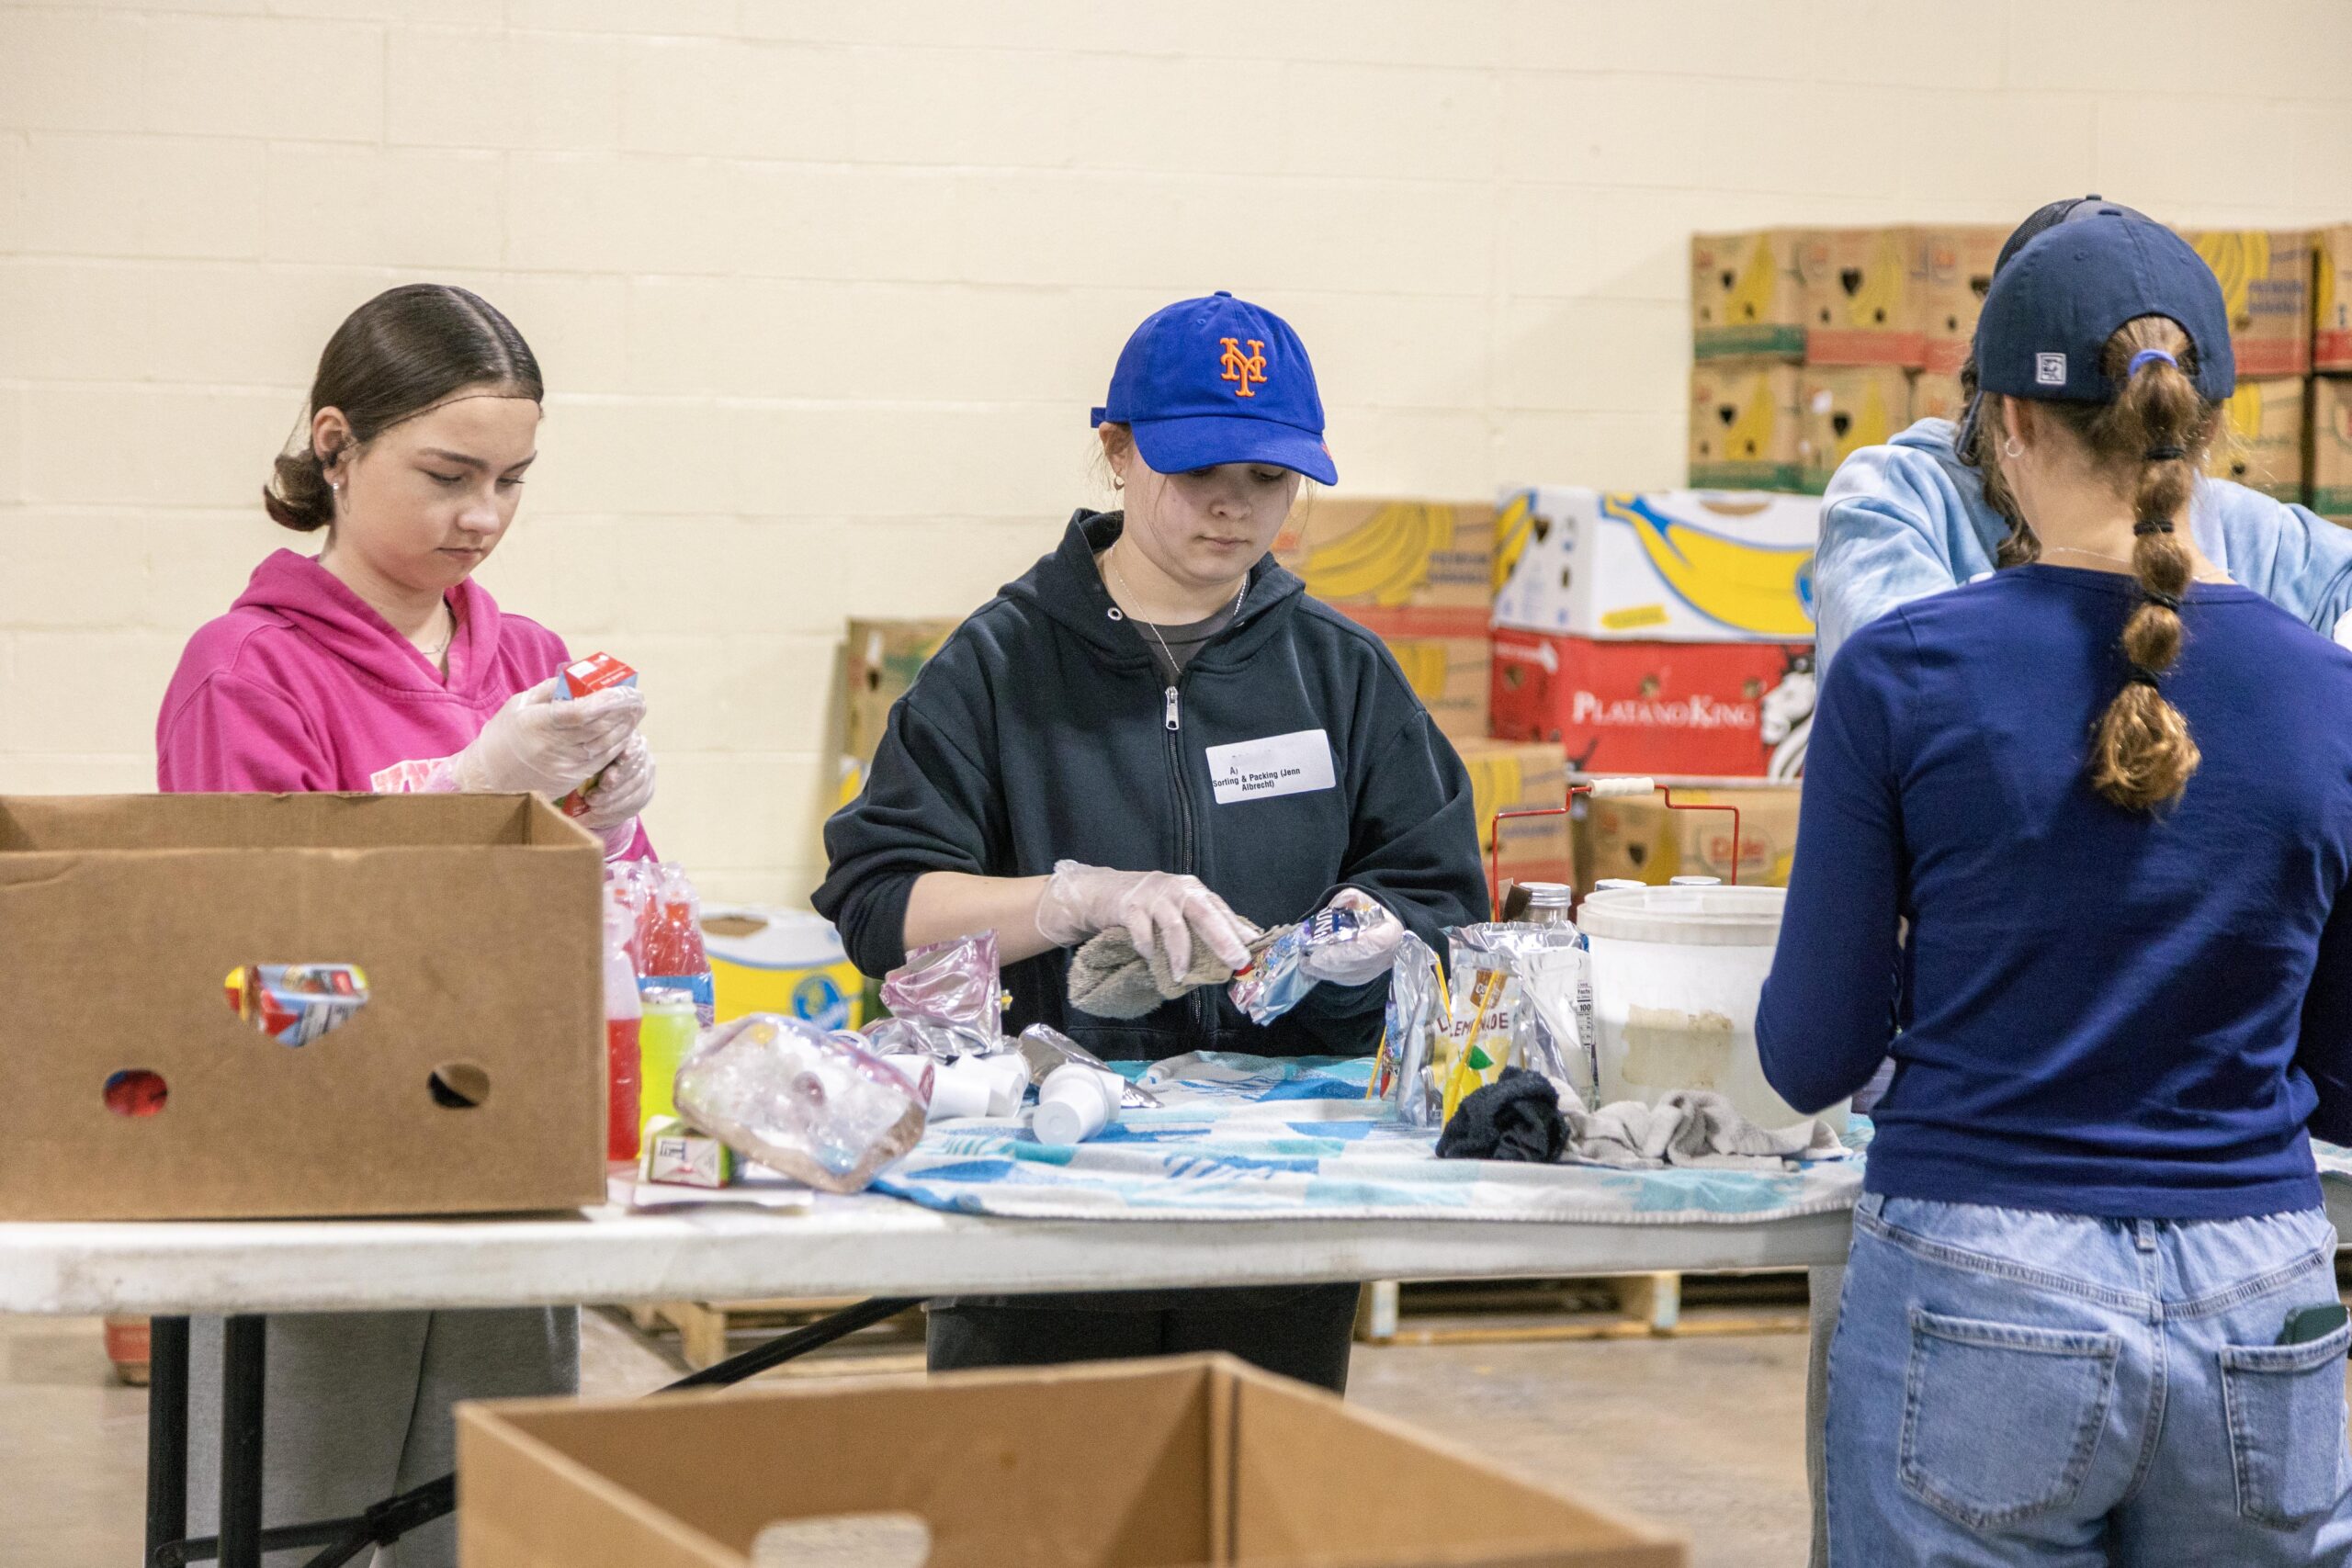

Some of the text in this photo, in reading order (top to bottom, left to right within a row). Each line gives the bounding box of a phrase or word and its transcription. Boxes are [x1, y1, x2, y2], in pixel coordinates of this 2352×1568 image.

[1220, 337, 1268, 397] NY
[1213, 777, 1239, 787] Sorting
[1250, 771, 1278, 782] Packing
[1280, 767, 1300, 778] (Jenn
[1241, 780, 1274, 792] Albrecht)
